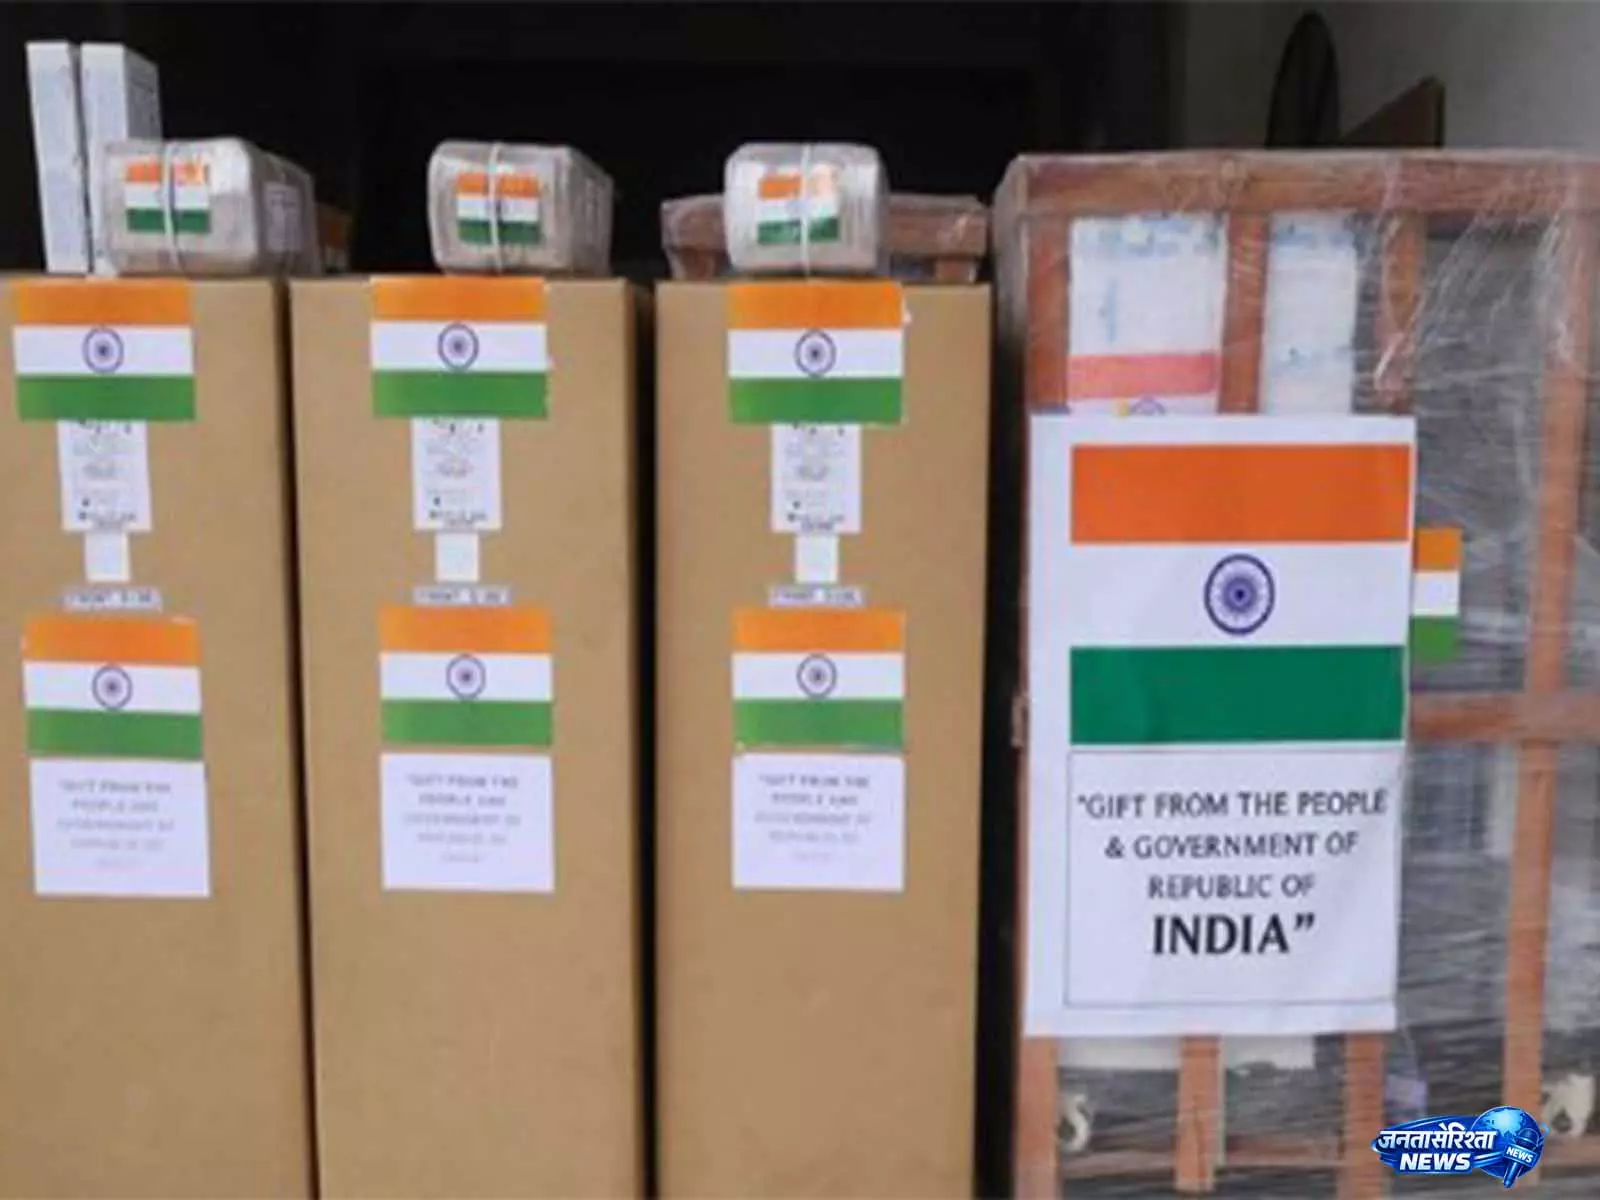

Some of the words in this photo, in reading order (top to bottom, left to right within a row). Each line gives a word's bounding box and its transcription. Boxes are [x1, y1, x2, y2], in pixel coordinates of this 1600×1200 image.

[1154, 792, 1229, 818] FROM
[1238, 791, 1288, 815] THE
[1297, 788, 1388, 815] PEOPLE
[1104, 836, 1126, 859] &
[1133, 832, 1319, 859] GOVERNMENT
[1325, 831, 1359, 856] OF
[1148, 873, 1273, 900] REPUBLIC
[1280, 873, 1315, 898] OF
